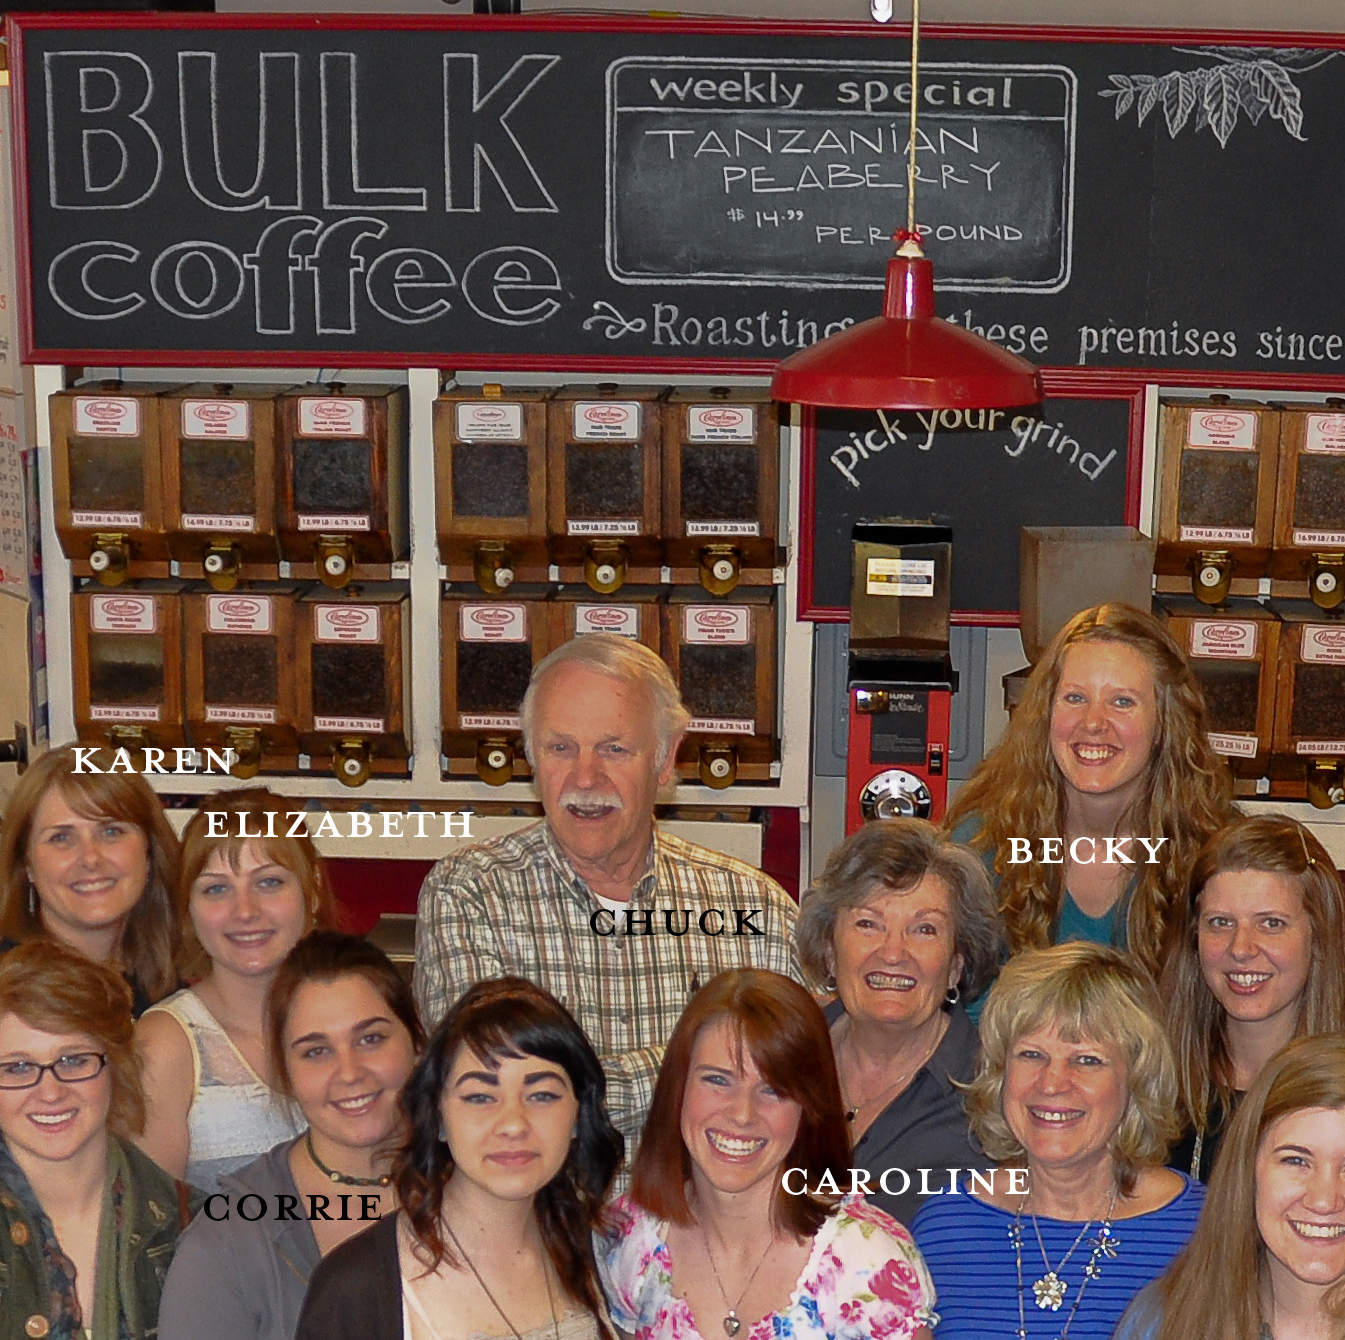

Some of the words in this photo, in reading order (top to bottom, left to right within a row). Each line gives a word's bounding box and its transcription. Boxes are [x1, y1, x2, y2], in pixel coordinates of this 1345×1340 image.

[649, 71, 803, 109] weekly
[836, 77, 1012, 112] special
[44, 50, 562, 213] BULK
[723, 160, 1001, 193] PEABERRY
[815, 225, 891, 245] PER
[48, 214, 562, 336] coffee
[1078, 320, 1238, 366] premises
[1256, 327, 1344, 362] since
[830, 408, 908, 490] pick
[916, 407, 1005, 451] your
[1004, 416, 1117, 481] grind
